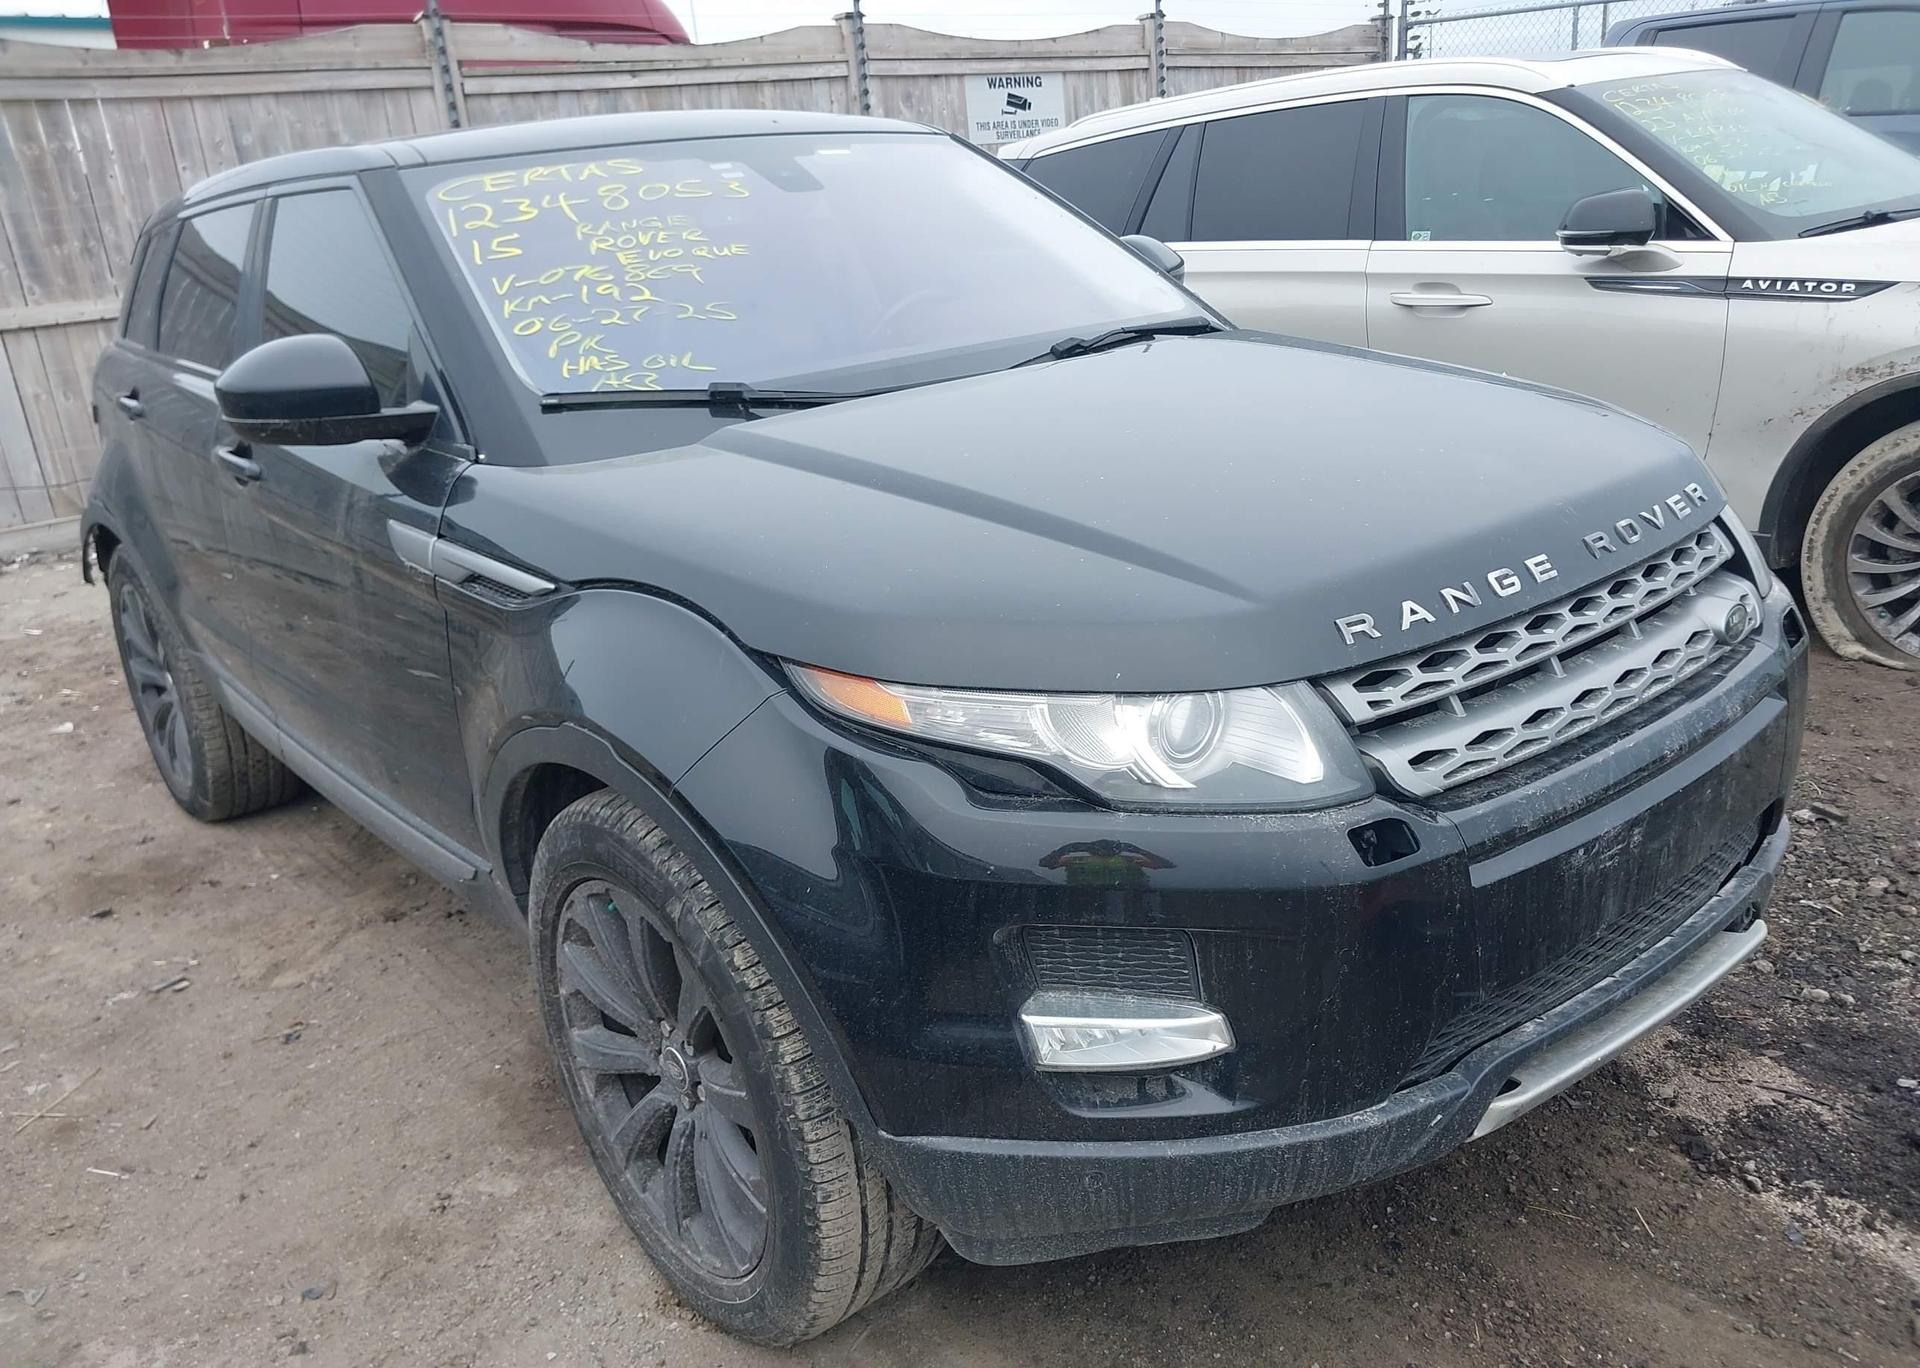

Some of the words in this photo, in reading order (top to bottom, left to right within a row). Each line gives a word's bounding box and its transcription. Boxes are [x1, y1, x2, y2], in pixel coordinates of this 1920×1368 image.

[987, 76, 1042, 89] WARNING
[976, 121, 991, 131] THIS
[992, 120, 1009, 130] AREA
[1010, 120, 1017, 129] IS
[1018, 119, 1040, 129] UNDER
[1041, 118, 1059, 127] VIDEO
[996, 129, 1041, 140] SURVEILLANCE
[438, 159, 643, 200] CERTAS
[576, 215, 689, 240] RANGE
[471, 232, 523, 265] 15
[590, 228, 710, 255] ROVER
[616, 243, 751, 265] EVOQUE
[1741, 279, 1856, 293] AVIATOR
[1334, 553, 1560, 645] RANGE
[1582, 482, 1709, 560] ROVER
